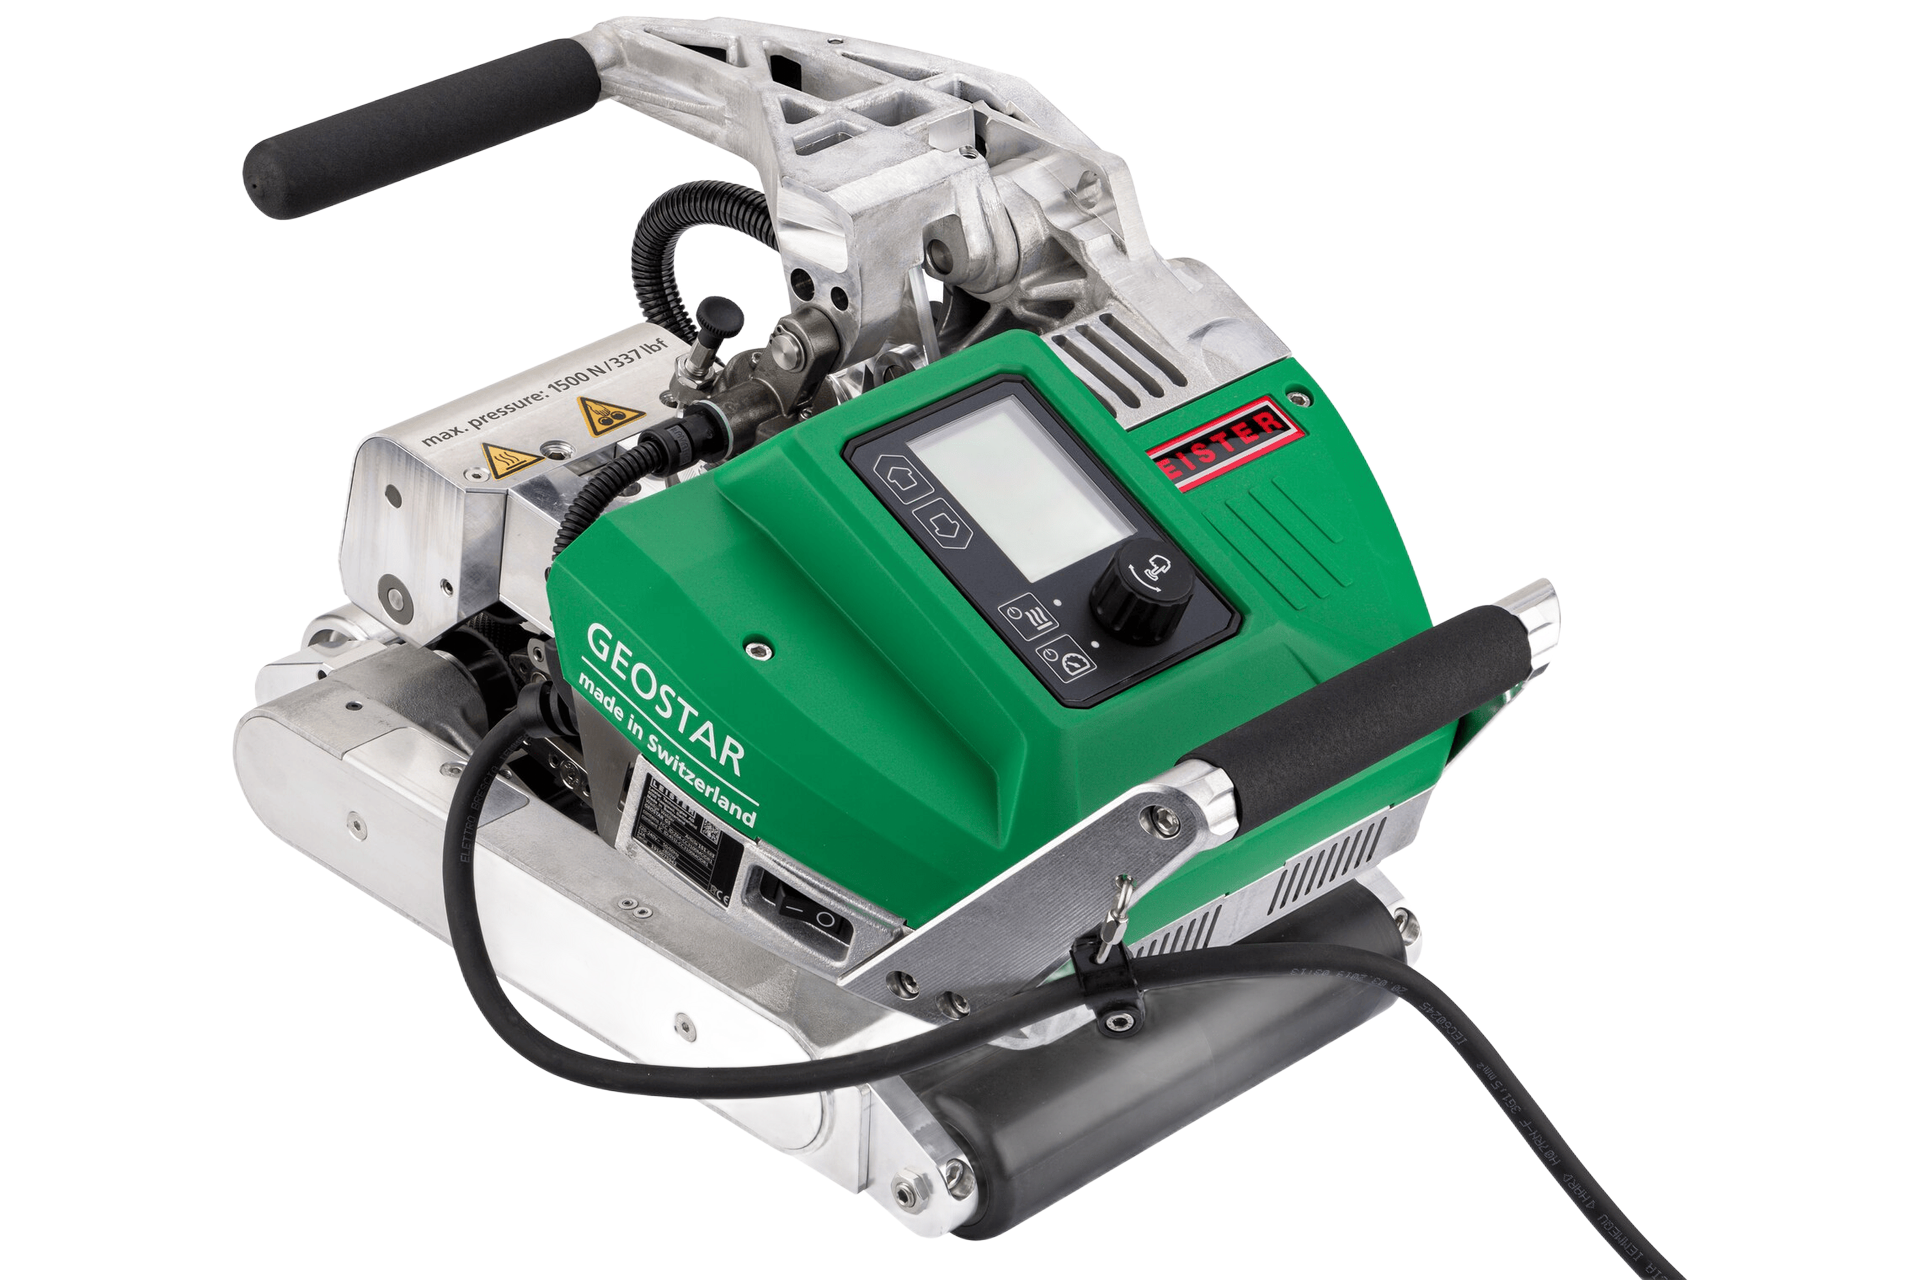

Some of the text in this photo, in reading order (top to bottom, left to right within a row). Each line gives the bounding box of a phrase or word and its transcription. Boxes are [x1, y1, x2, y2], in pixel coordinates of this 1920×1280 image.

[421, 423, 469, 448] max.
[468, 390, 550, 430] pressure:
[547, 372, 590, 393] 1500
[639, 337, 669, 356] lbf
[587, 622, 745, 777] GEOSTAR
[578, 672, 624, 721] made
[627, 714, 644, 740] in
[647, 734, 757, 828] Switzerland
[460, 815, 476, 863] ELETTRO
[1418, 1002, 1468, 1046] IEC60245
[1519, 1120, 1561, 1166] H07RN-F
[1597, 1213, 1644, 1262] IEMMEQU
